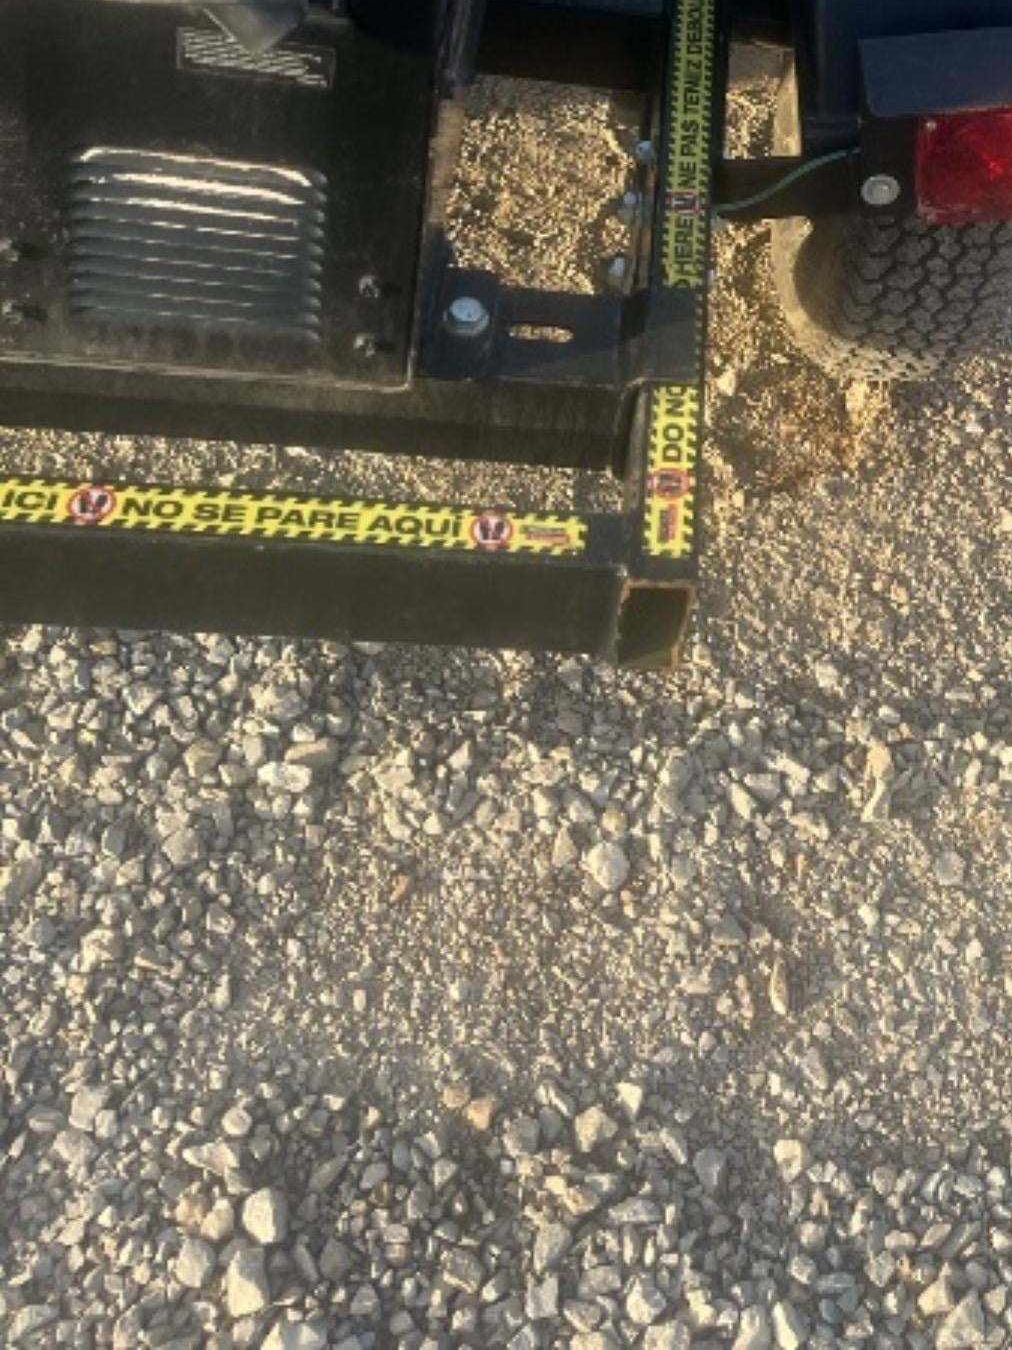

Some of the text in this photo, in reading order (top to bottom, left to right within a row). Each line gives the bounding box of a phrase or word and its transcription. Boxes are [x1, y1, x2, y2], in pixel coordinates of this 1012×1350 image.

[680, 118, 699, 157] PAS
[678, 161, 697, 189] NE
[673, 216, 695, 276] HERE
[662, 423, 684, 462] DO
[122, 497, 184, 518] NO
[193, 503, 247, 523] SE
[255, 506, 360, 529] PARE
